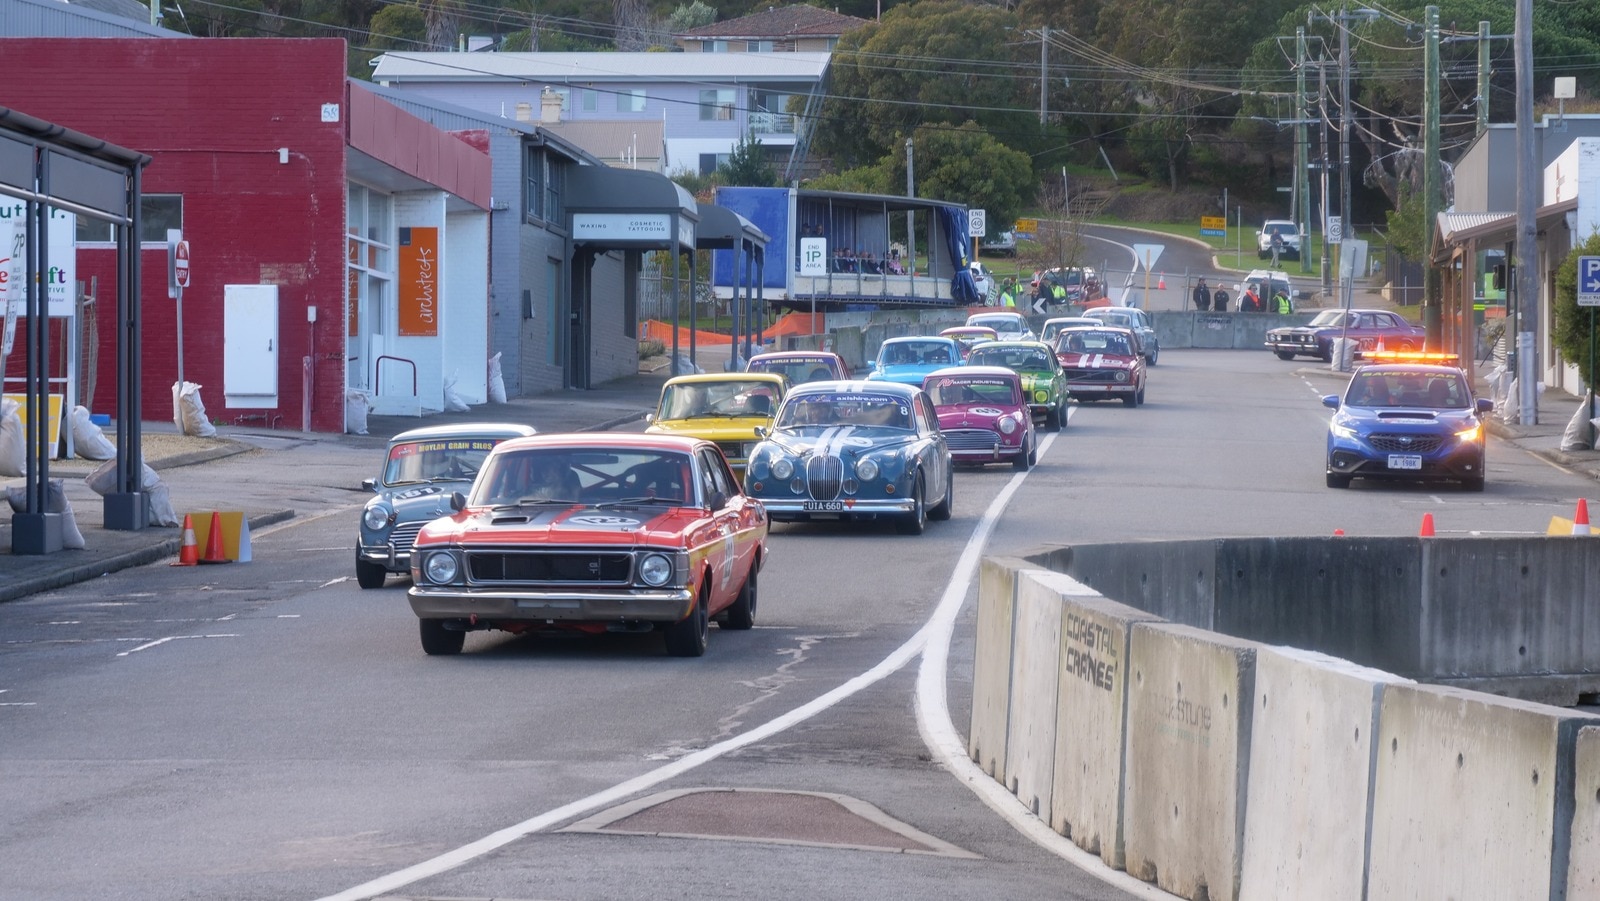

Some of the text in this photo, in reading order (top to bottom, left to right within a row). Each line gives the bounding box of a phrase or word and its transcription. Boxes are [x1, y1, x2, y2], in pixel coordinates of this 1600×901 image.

[13, 233, 25, 258] 2P
[806, 251, 821, 262] 1P
[1588, 261, 1600, 277] P
[900, 407, 908, 415] 8
[419, 443, 446, 452] MOYLAN
[1066, 612, 1118, 658] COASTAL
[1065, 646, 1114, 692] CRANES
